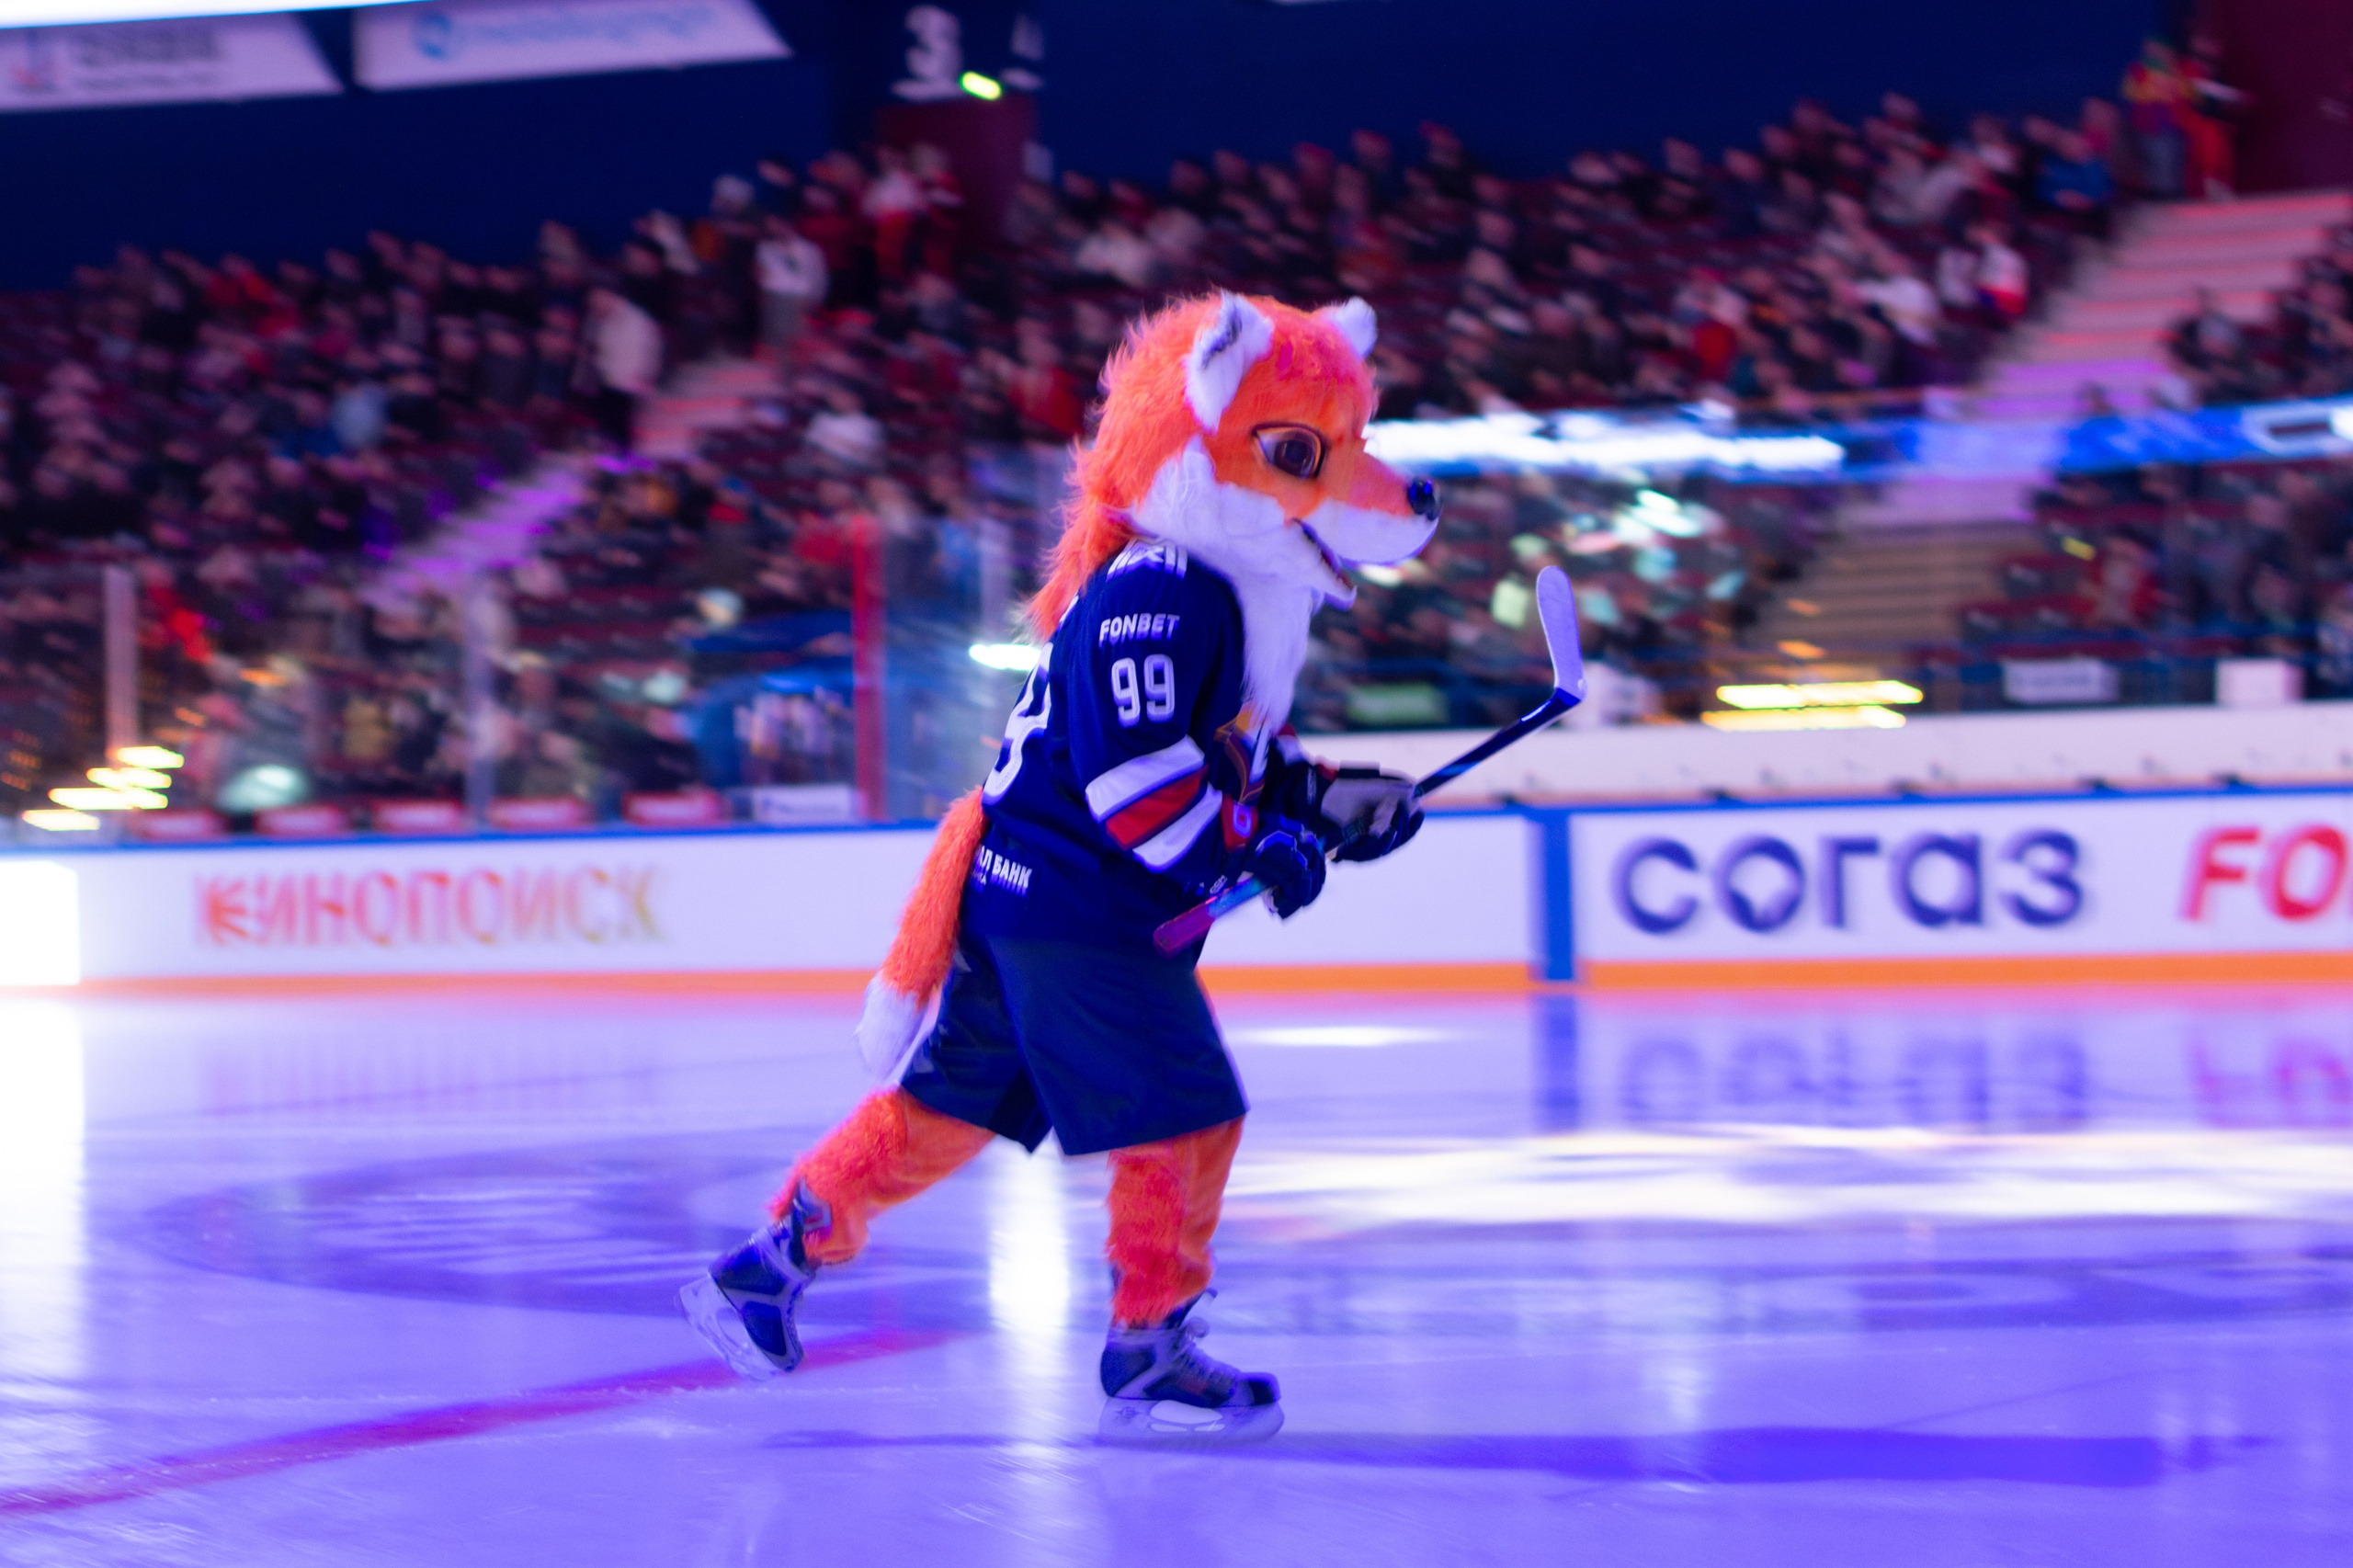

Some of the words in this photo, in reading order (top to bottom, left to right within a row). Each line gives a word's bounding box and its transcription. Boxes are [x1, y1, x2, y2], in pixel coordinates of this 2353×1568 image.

[1098, 612, 1180, 648] FONBET
[1111, 653, 1176, 729] 99
[196, 866, 665, 947] КИНОПОИСК
[990, 853, 1033, 896] БАНК
[2178, 824, 2353, 925] FO
